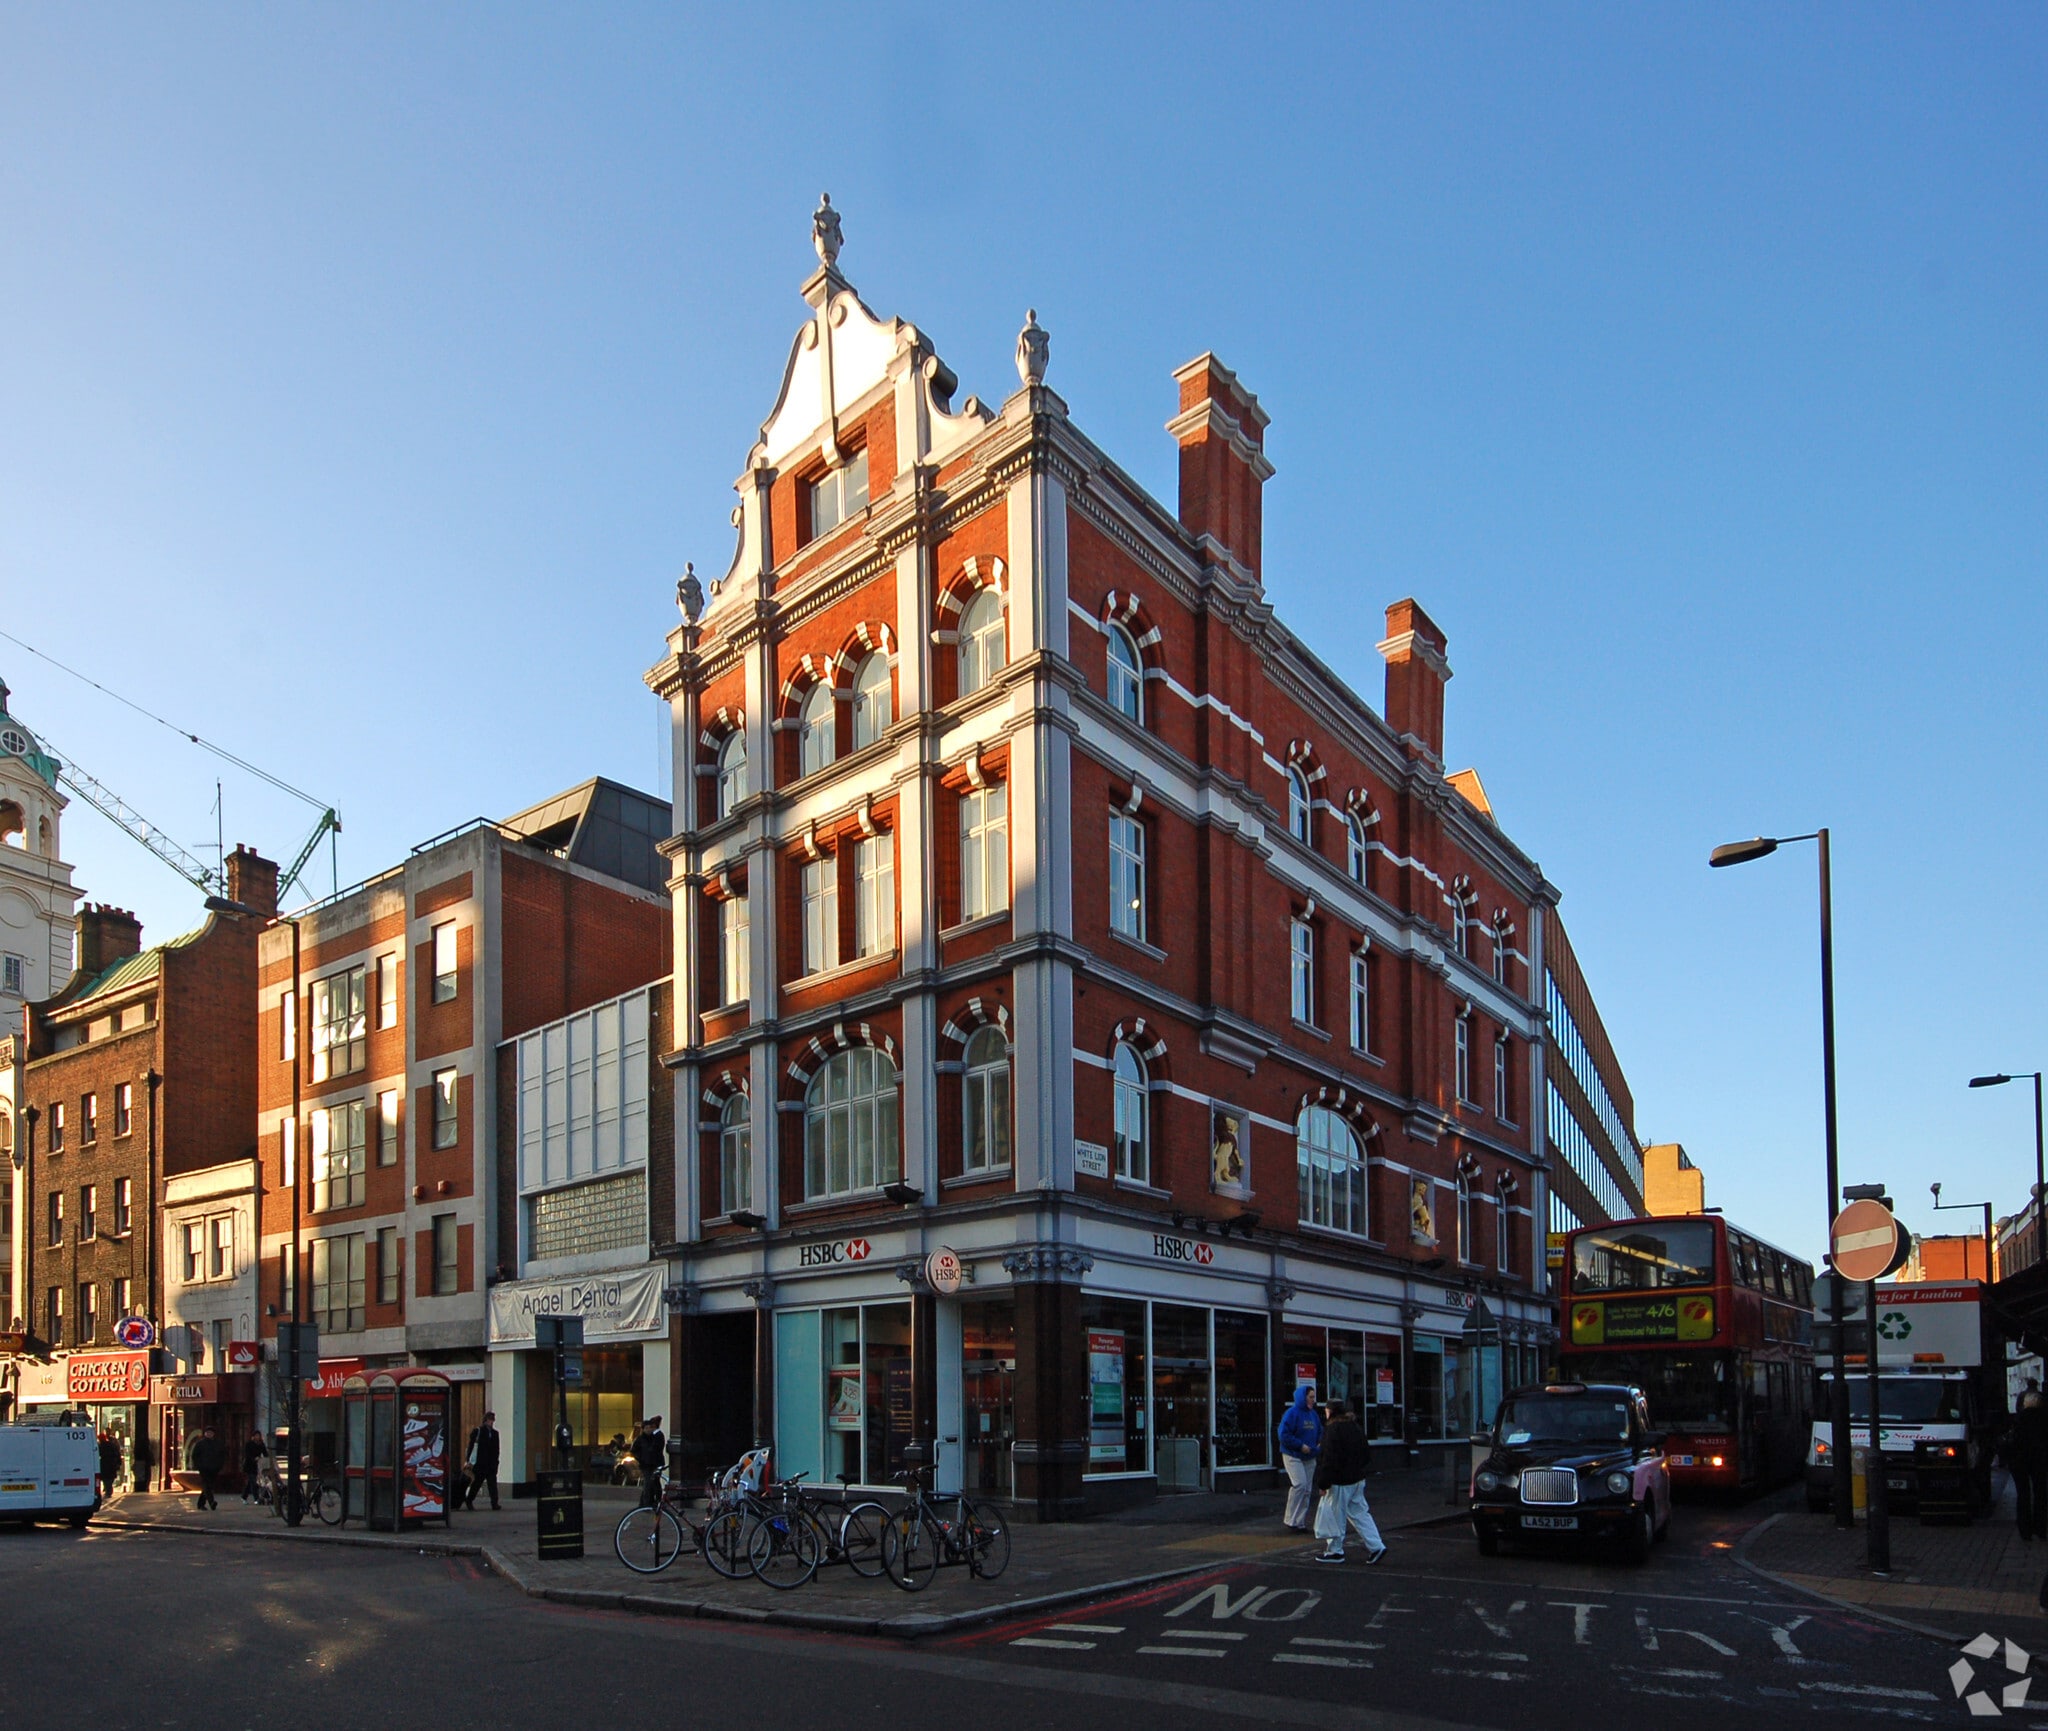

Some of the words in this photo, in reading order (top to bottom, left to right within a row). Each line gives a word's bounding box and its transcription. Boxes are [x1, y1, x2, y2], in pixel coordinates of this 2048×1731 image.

[1077, 1148, 1093, 1159] WHITE
[1094, 1152, 1106, 1162] LION
[1082, 1159, 1101, 1171] STREET
[800, 1241, 844, 1266] HSBC
[1153, 1234, 1193, 1261] HSBC
[935, 1269, 960, 1281] HSBC
[522, 1288, 563, 1316] Angel
[572, 1281, 621, 1310] Dental
[1445, 1290, 1466, 1307] HSBC
[1890, 1291, 1910, 1303] for
[1912, 1289, 1963, 1300] London
[1646, 1304, 1675, 1318] 476
[70, 1361, 129, 1377] CHICKEN
[70, 1378, 127, 1393] COTTAGE
[66, 1432, 86, 1441] 103
[1525, 1517, 1551, 1527] LA52
[1553, 1518, 1573, 1528] BUP
[1165, 1583, 1322, 1622] NO
